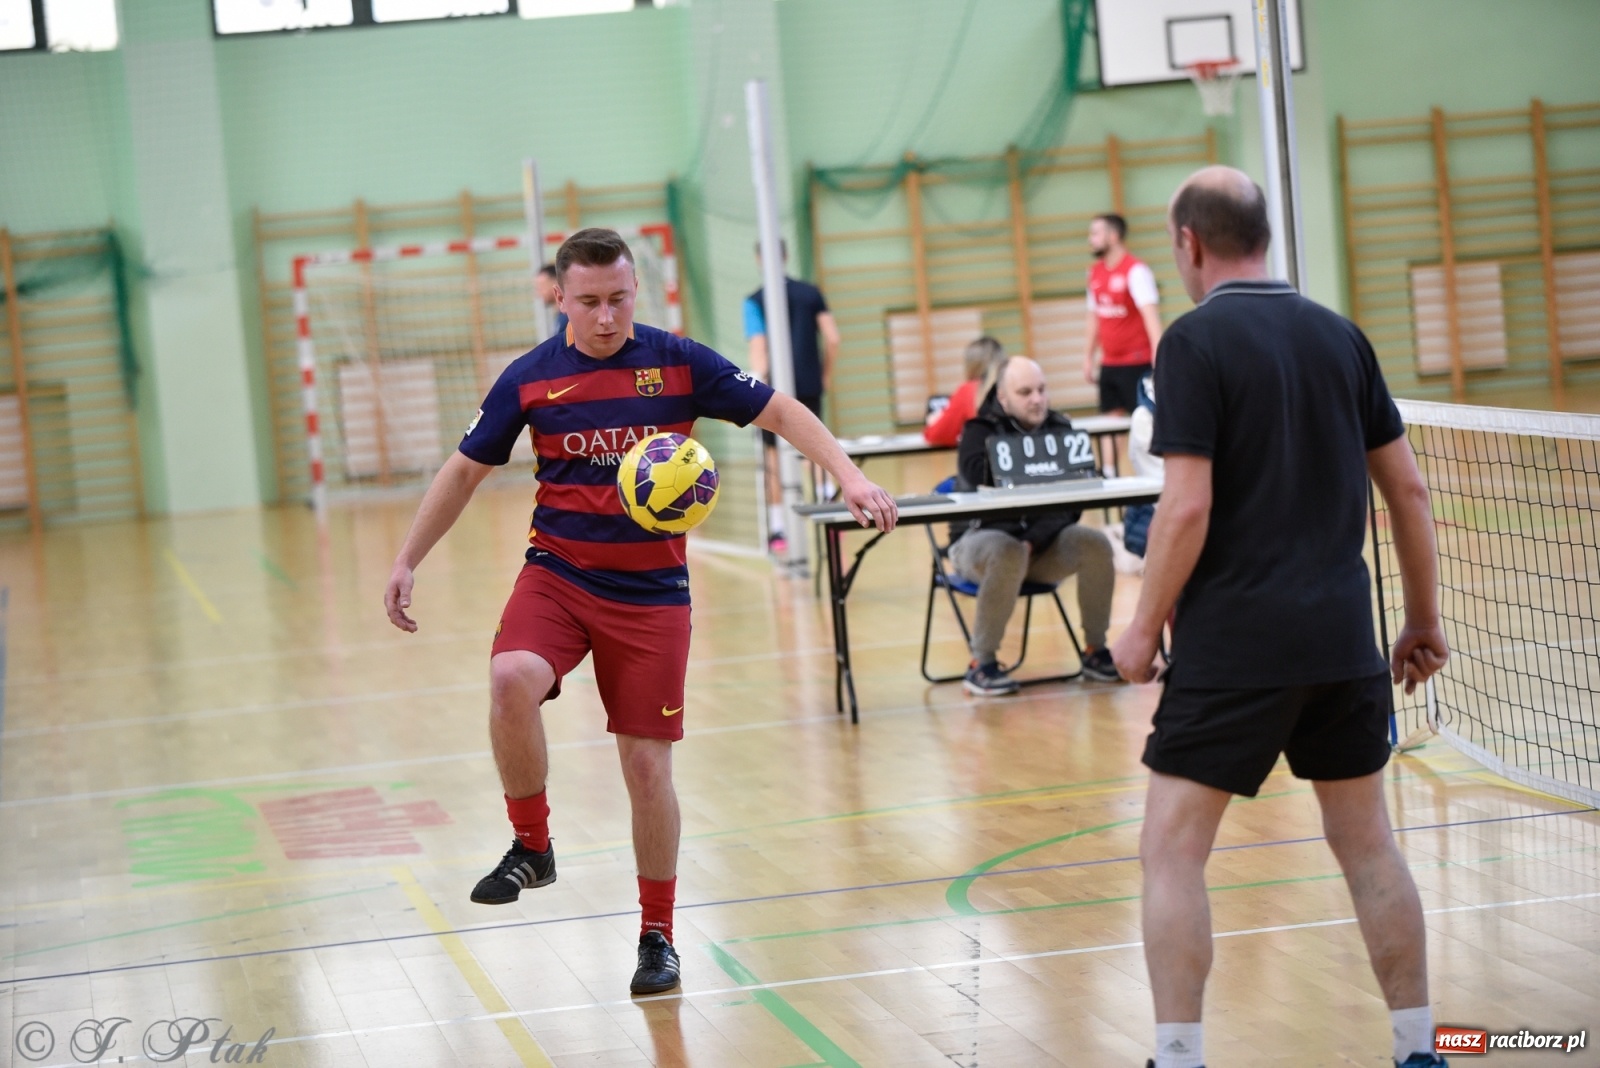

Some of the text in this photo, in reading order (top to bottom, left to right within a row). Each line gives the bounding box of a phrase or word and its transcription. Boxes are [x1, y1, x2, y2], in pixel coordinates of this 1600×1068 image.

[996, 431, 1095, 471] 8 0 0 22
